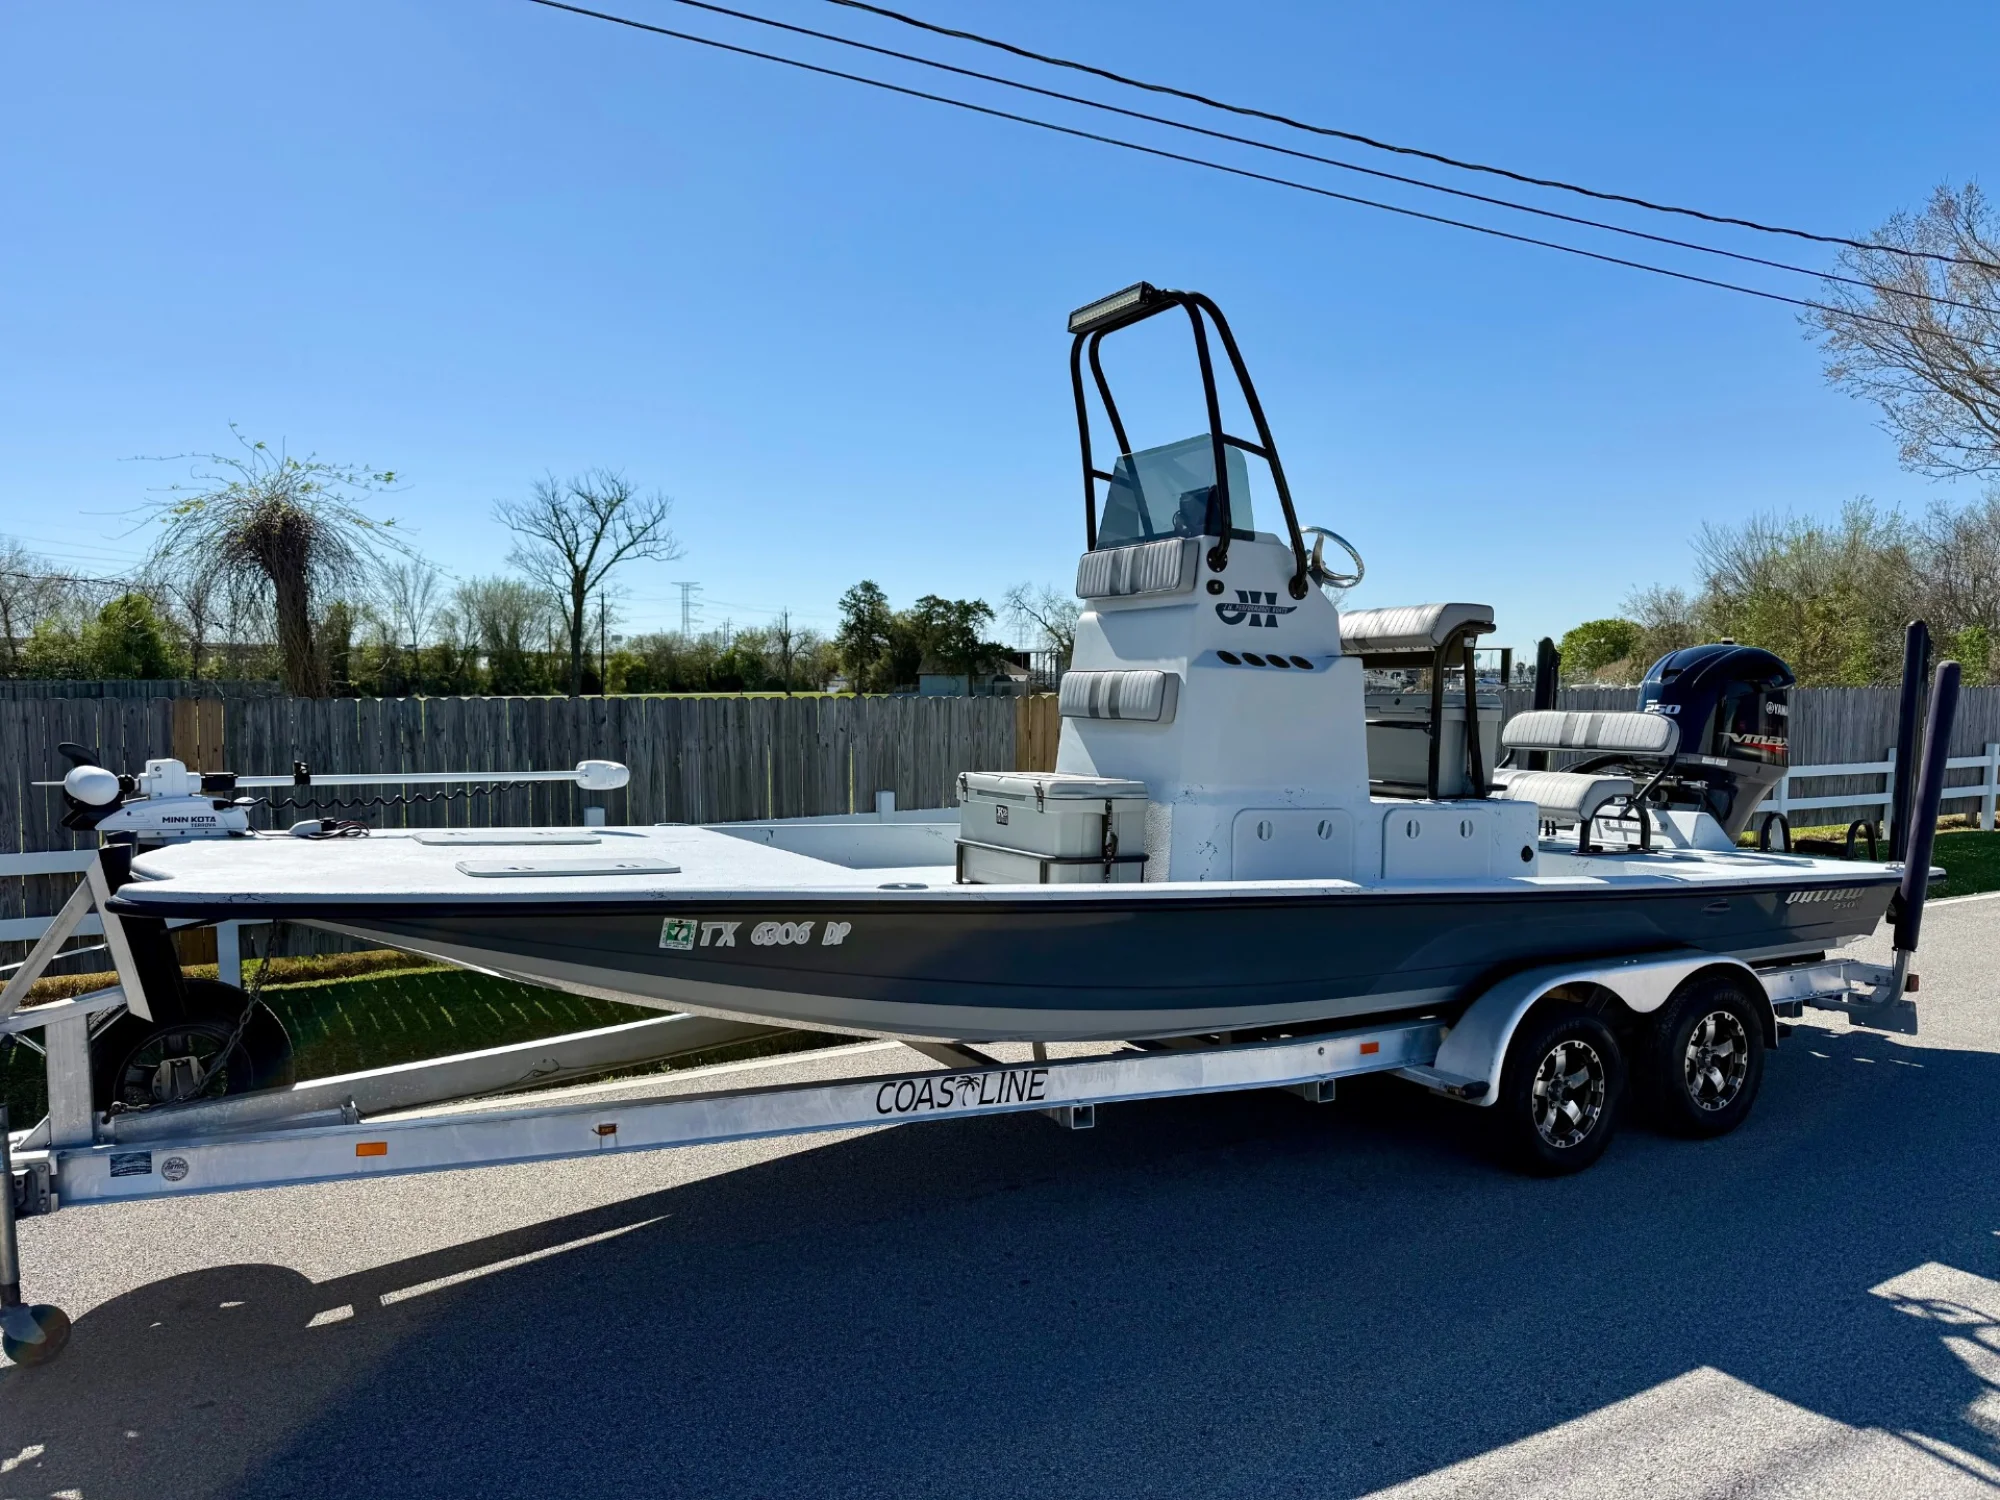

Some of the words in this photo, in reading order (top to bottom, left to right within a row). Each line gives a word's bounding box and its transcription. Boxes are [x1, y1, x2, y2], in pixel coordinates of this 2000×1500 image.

[1644, 704, 1682, 714] 250
[997, 807, 1008, 817] K2
[700, 921, 742, 948] TX
[750, 921, 816, 946] 6306
[821, 921, 852, 946] DP
